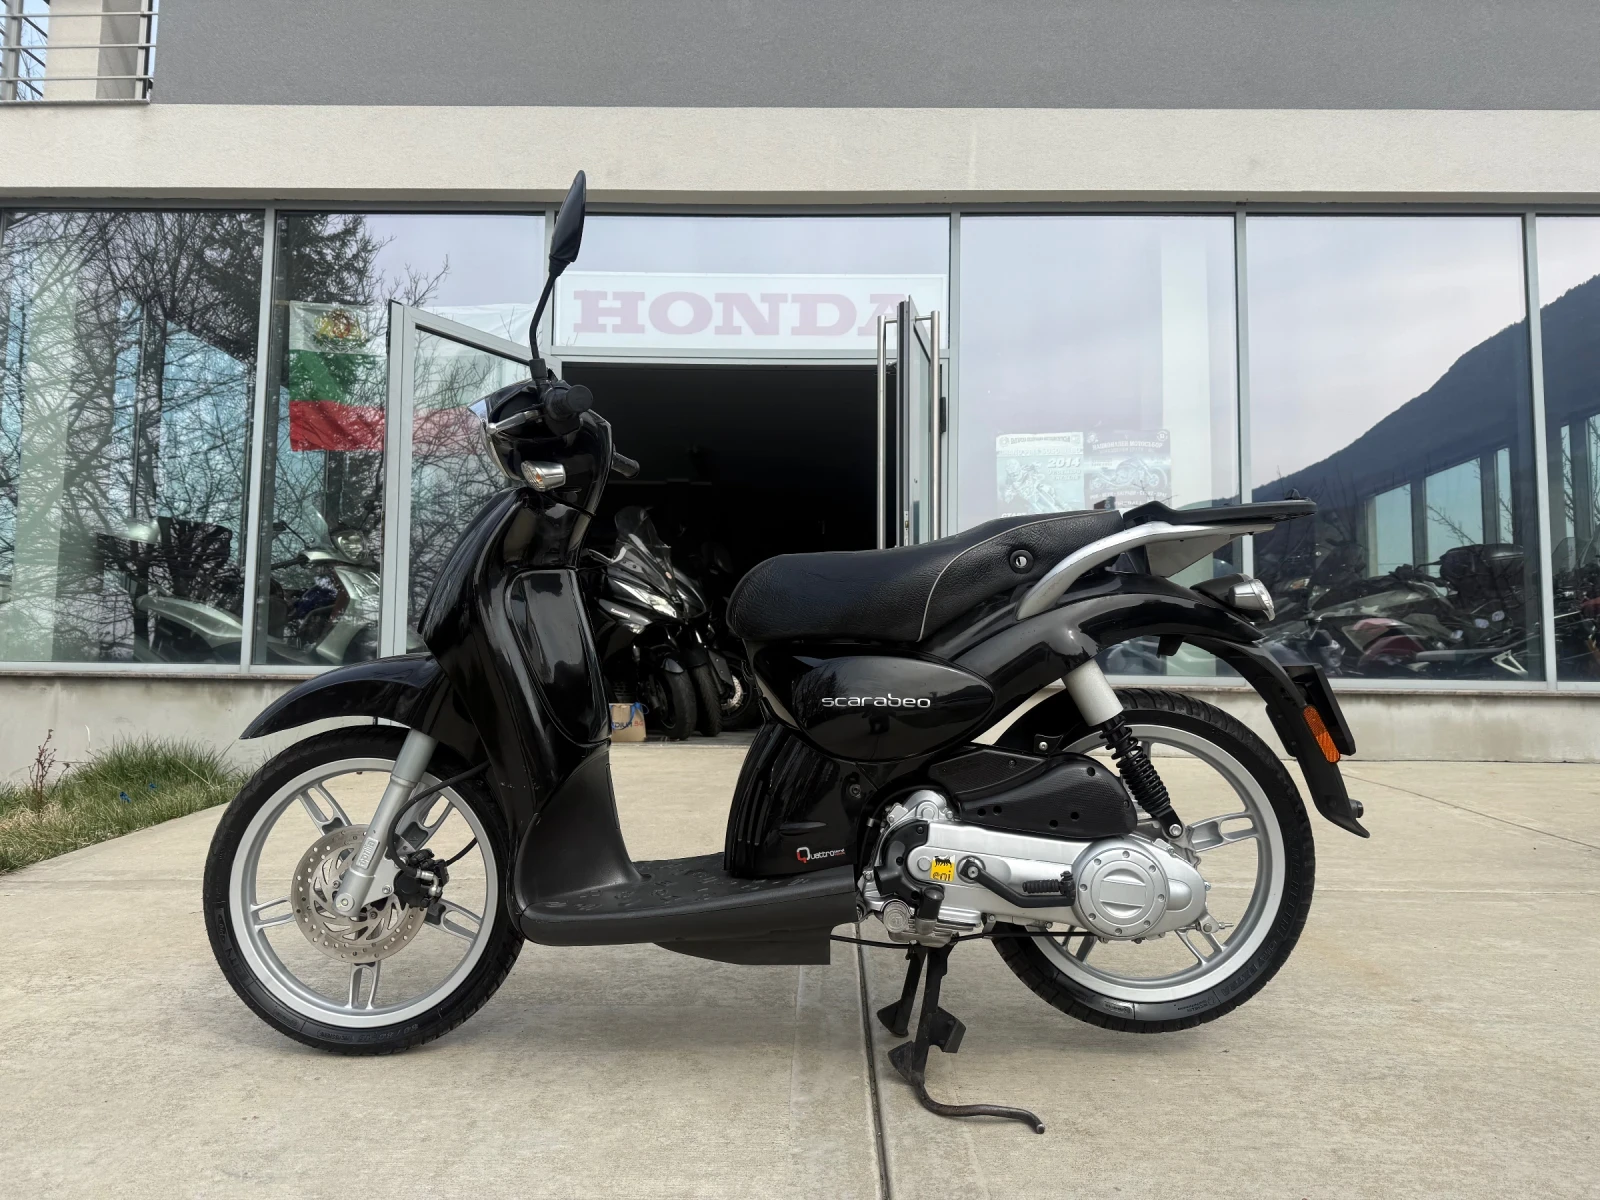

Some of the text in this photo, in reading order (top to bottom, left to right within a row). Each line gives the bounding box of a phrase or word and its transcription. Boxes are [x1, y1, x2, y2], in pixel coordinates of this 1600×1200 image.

[573, 290, 908, 336] HONDA
[1047, 457, 1081, 468] 2014
[821, 693, 931, 708] scarabeo
[932, 869, 952, 882] eni
